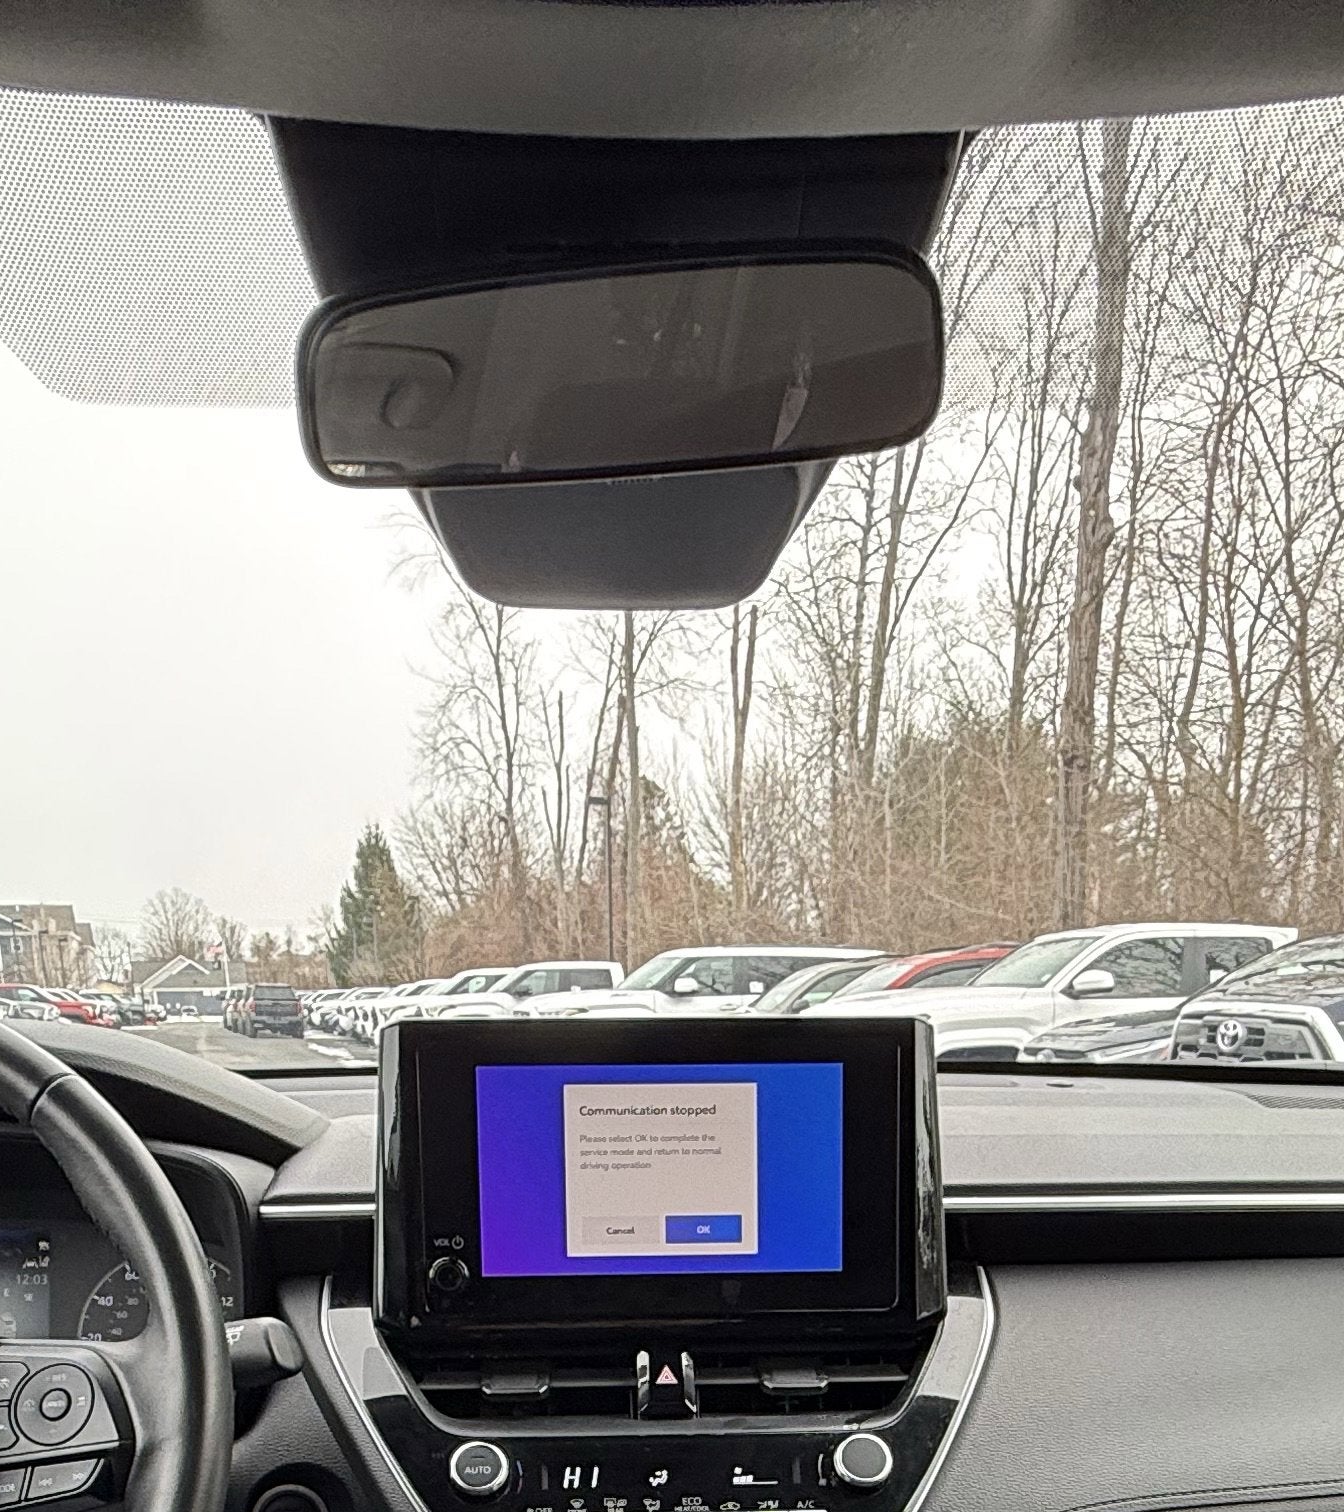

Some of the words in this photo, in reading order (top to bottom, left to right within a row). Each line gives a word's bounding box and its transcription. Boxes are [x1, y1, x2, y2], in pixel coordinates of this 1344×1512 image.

[579, 1105, 668, 1116] Communication
[670, 1104, 716, 1117] stopped
[579, 1135, 606, 1143] Please
[608, 1135, 632, 1143] select
[635, 1135, 648, 1143] OK
[649, 1135, 658, 1143] to
[660, 1134, 700, 1144] complete
[702, 1134, 716, 1142] the
[580, 1148, 608, 1157] service
[610, 1148, 634, 1156] mode
[637, 1148, 652, 1156] and
[654, 1148, 680, 1156] return
[681, 1148, 691, 1156] to
[692, 1147, 722, 1156] normal
[580, 1162, 609, 1171] driving
[606, 1226, 635, 1235] Cancel
[696, 1225, 711, 1234] OK
[16, 1274, 48, 1285] 12:03
[464, 1466, 492, 1475] AUTO
[563, 1465, 599, 1489] HI
[682, 1497, 702, 1506] ECO
[796, 1500, 815, 1509] A/C
